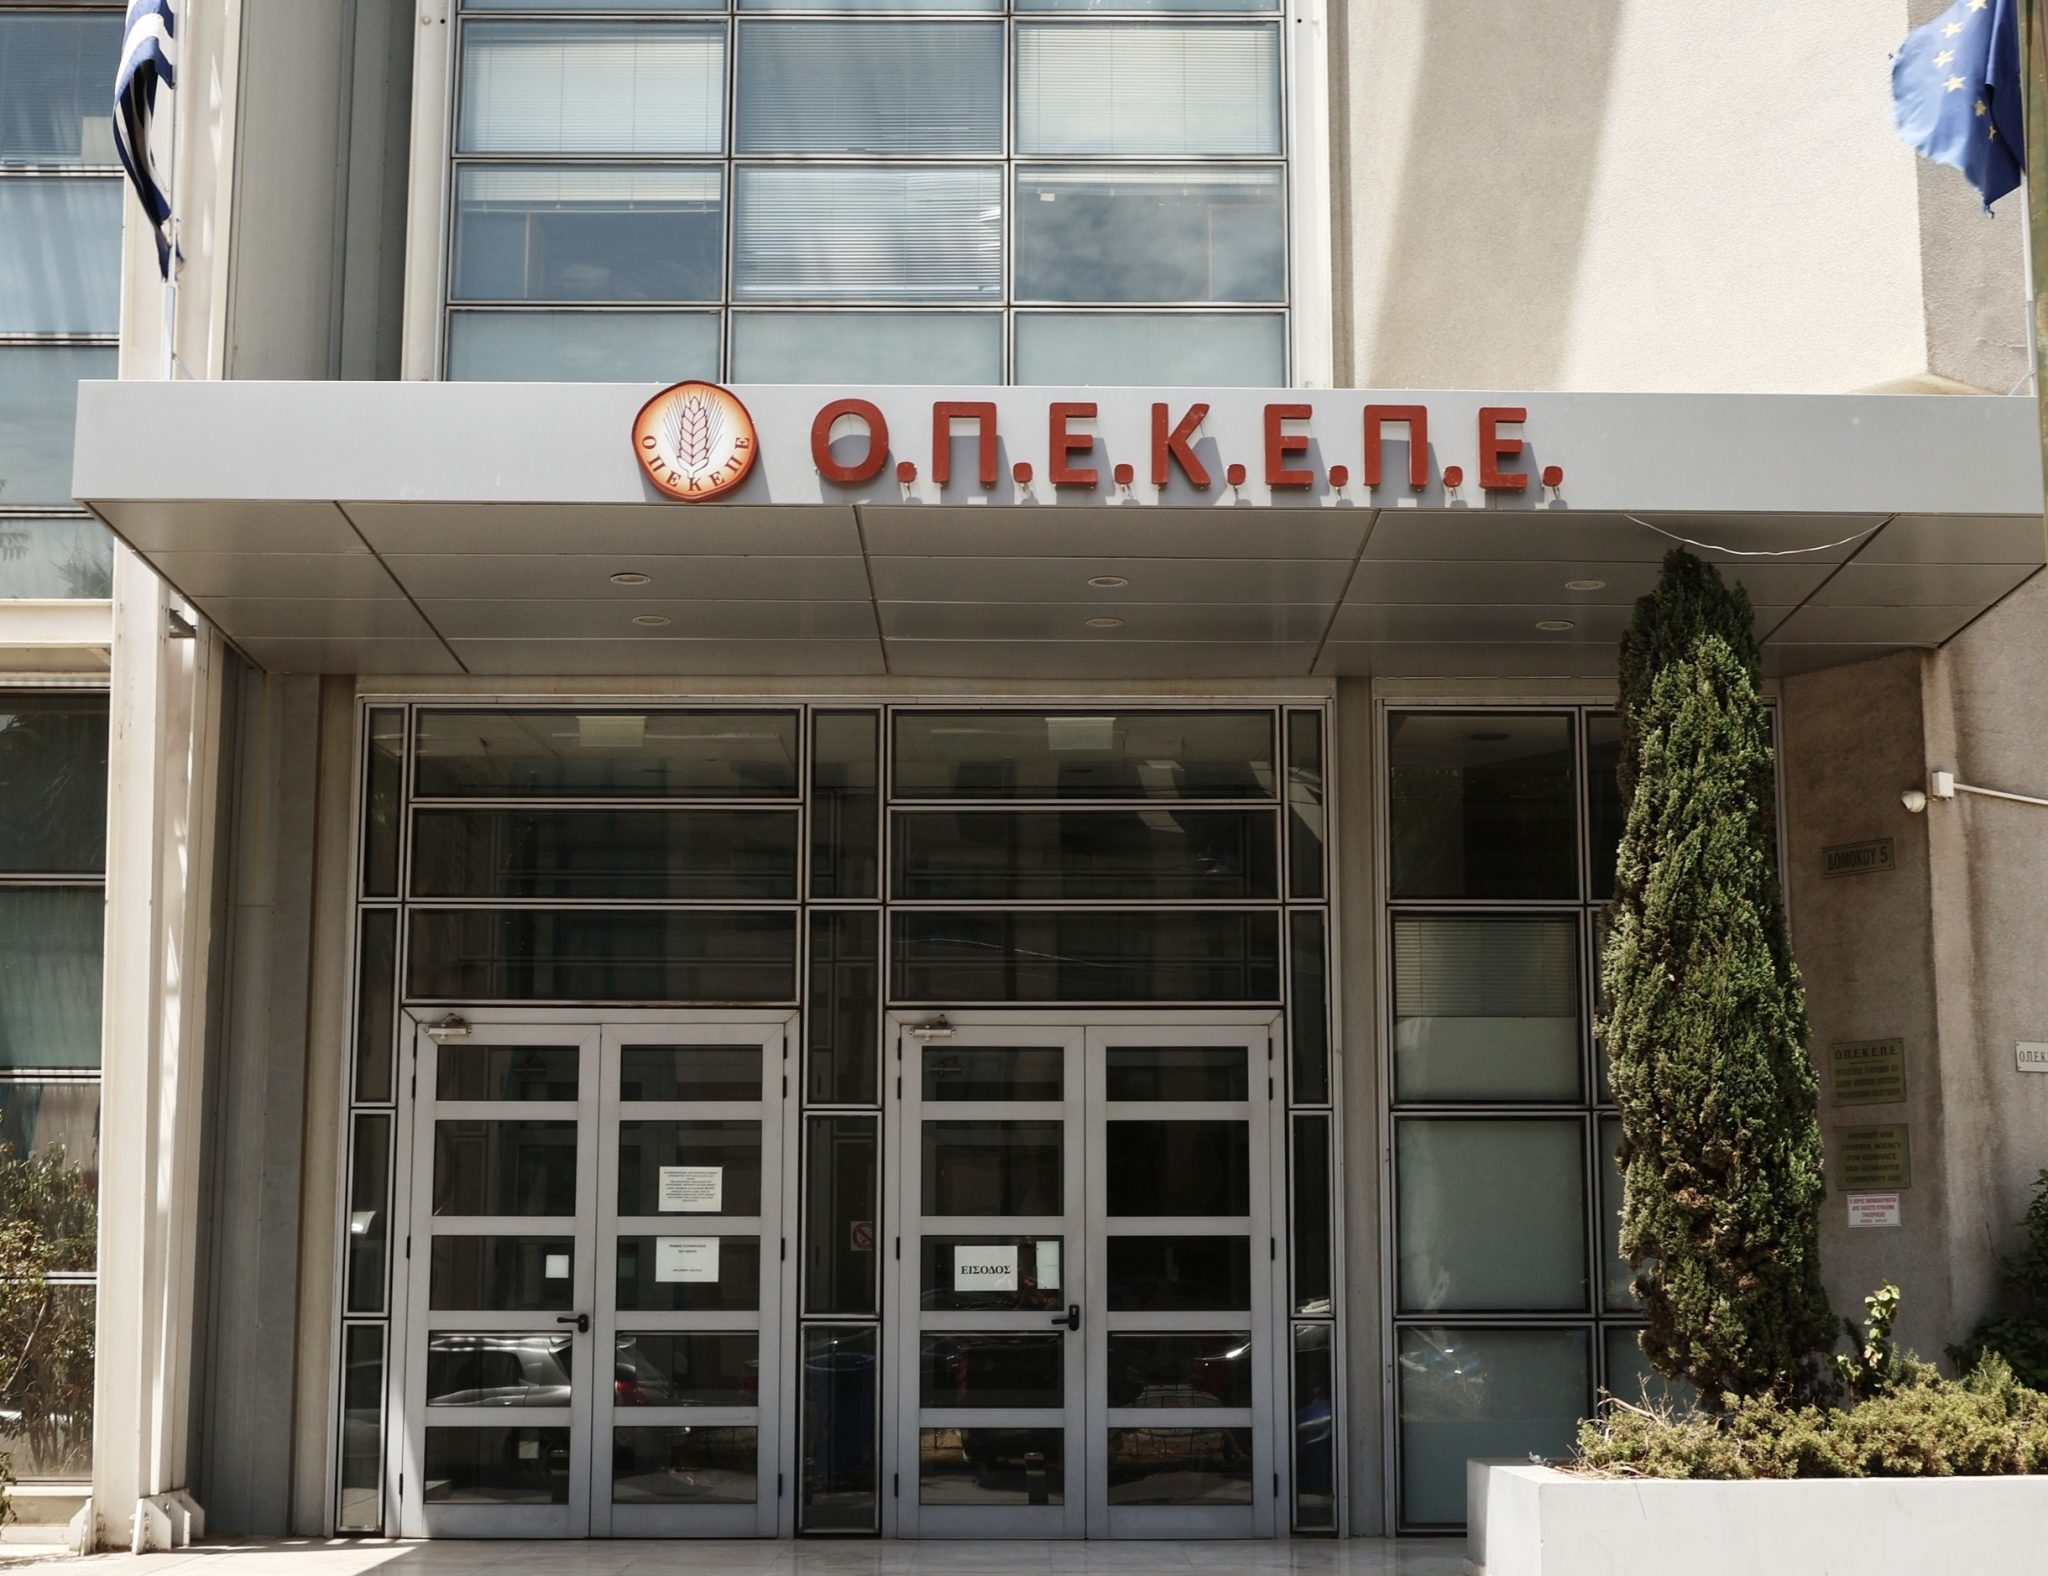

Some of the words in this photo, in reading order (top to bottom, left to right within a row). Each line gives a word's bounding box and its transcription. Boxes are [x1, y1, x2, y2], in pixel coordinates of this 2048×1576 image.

[641, 435, 750, 492] ΟΠΕΚΕΠΕ
[811, 399, 1563, 490] Ο.Π.Ε.Κ.Ε.Π.Ε.
[1827, 847, 1876, 871] ΔΟΜΟΚΟΥ
[1880, 846, 1889, 863] 5
[960, 1265, 1012, 1275] ΕΙΣΟΔΟΣ
